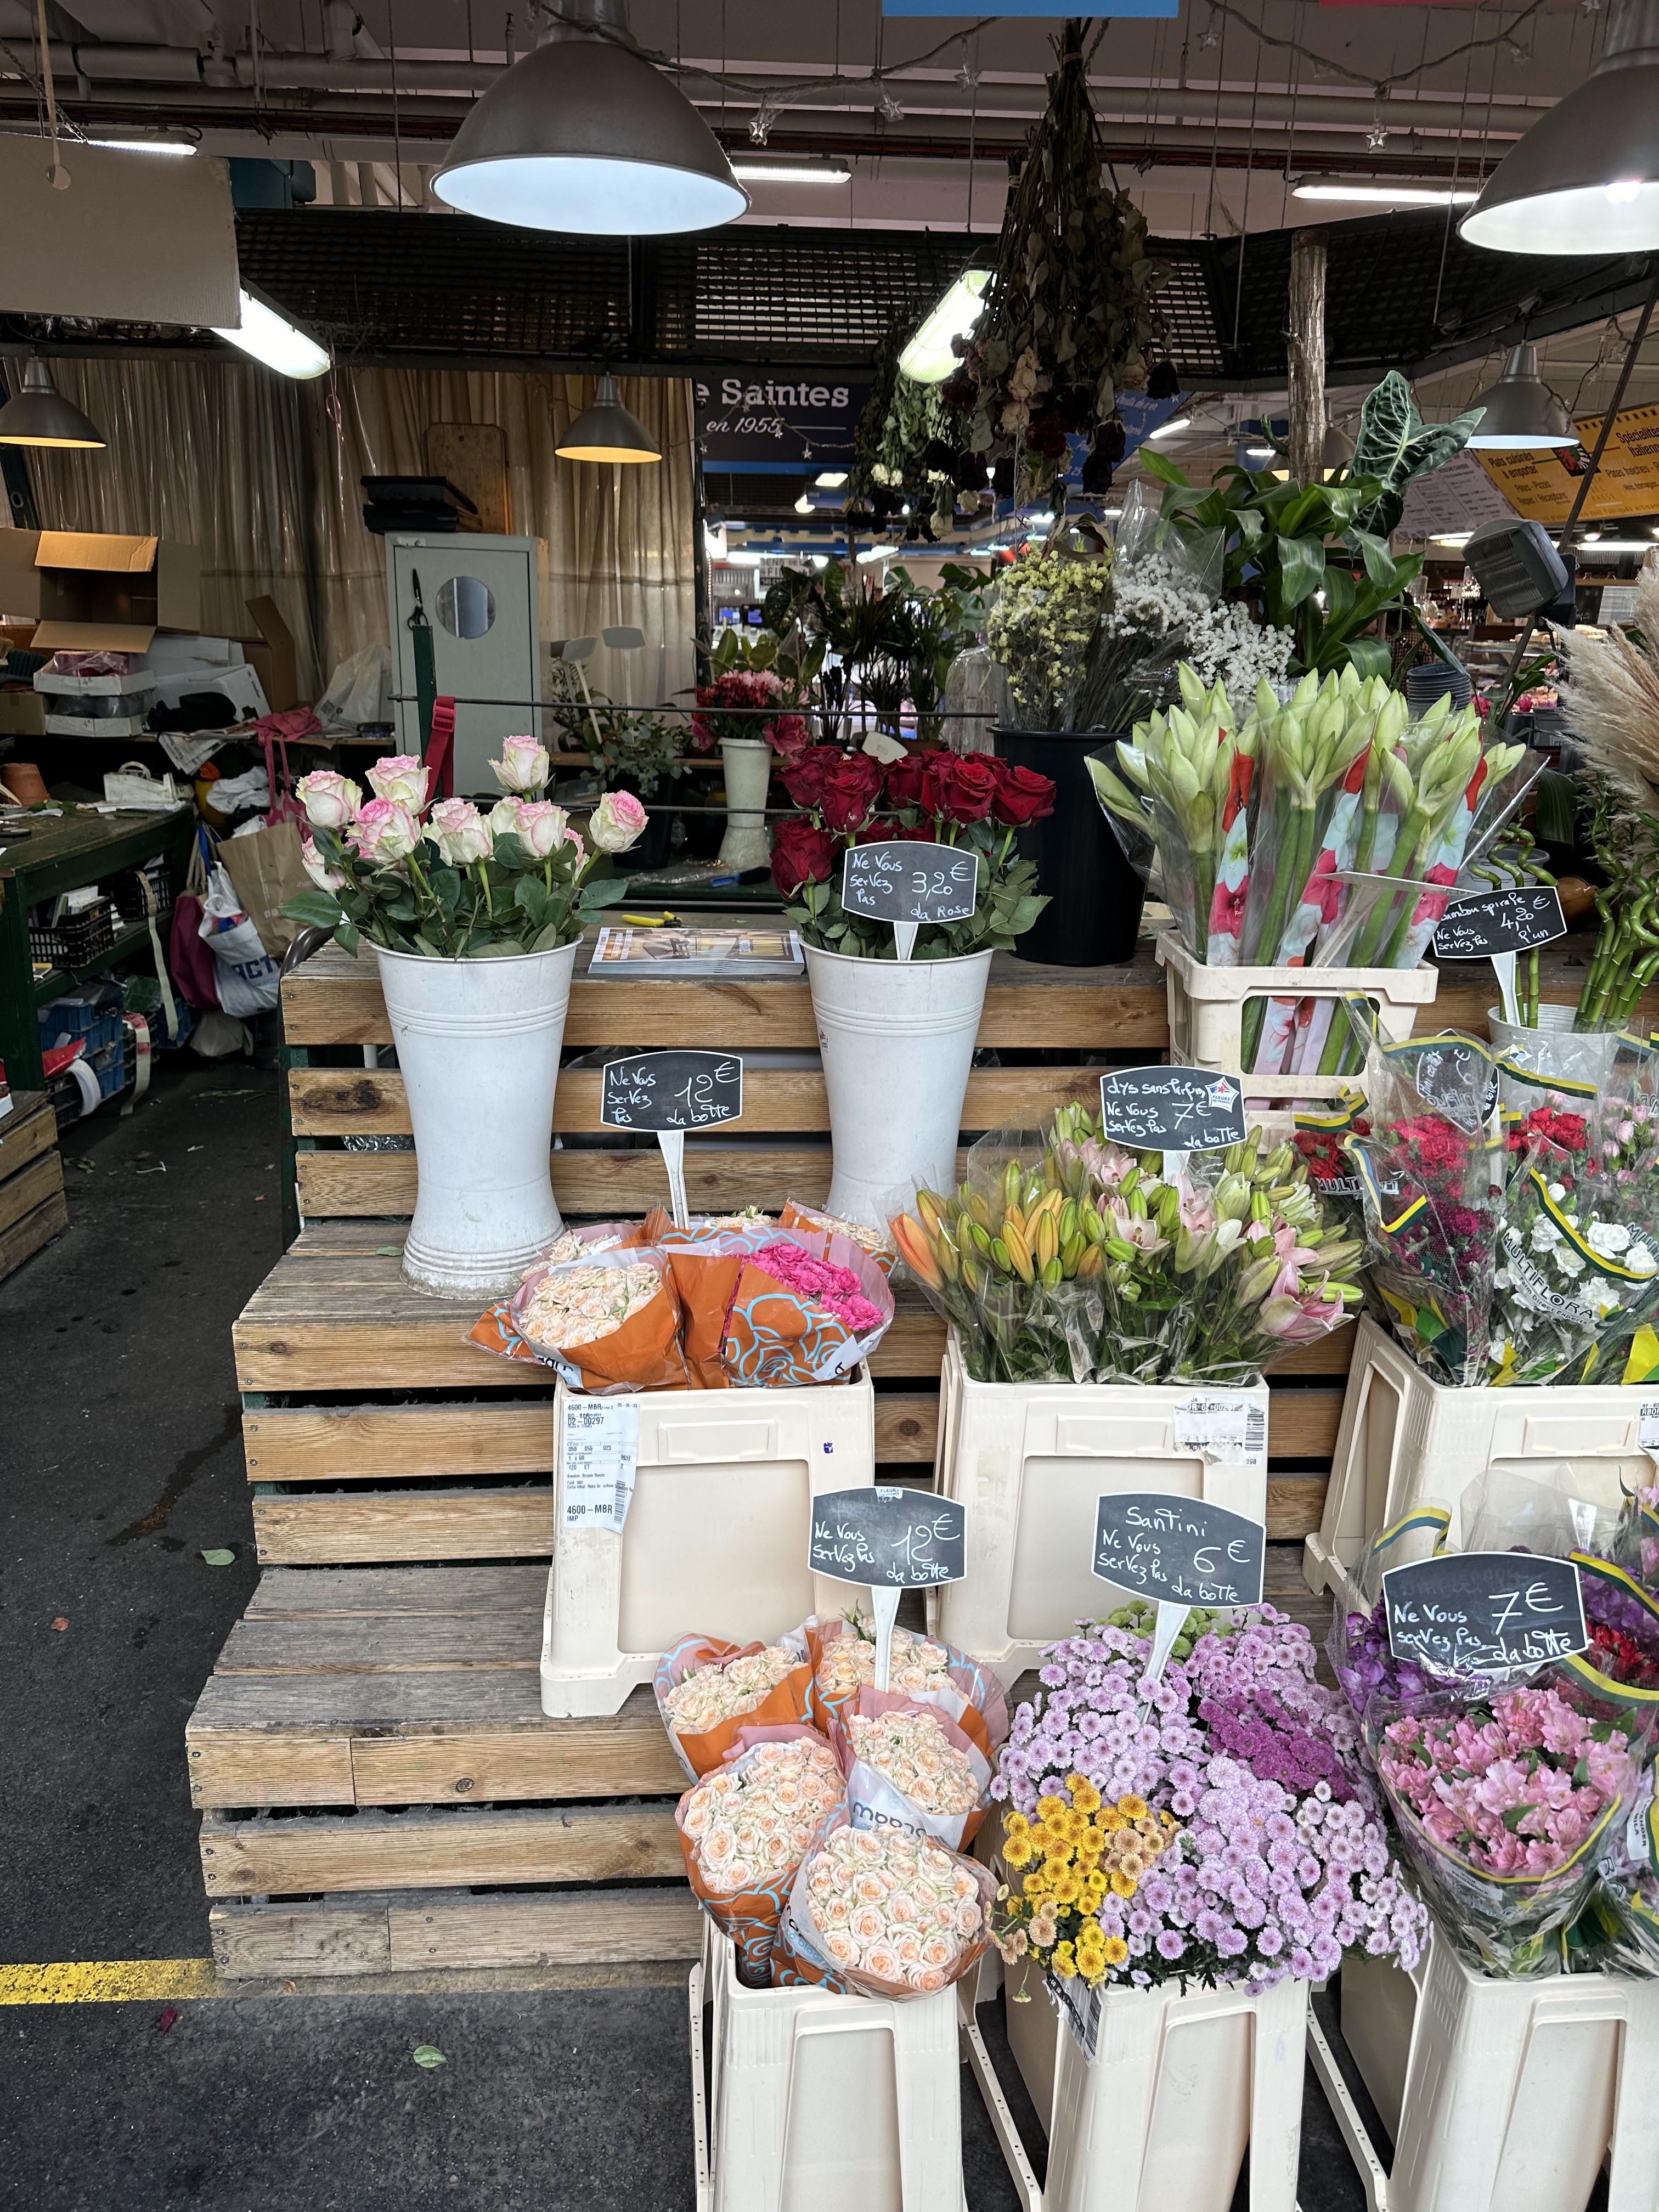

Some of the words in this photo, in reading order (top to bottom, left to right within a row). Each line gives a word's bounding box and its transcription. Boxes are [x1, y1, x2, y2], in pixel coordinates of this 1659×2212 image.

[722, 379, 849, 407] Saintes
[707, 420, 730, 432] en
[735, 417, 785, 433] 1955
[852, 853, 870, 868] Ne
[875, 851, 902, 871] Vous
[856, 888, 876, 905] Pas
[1441, 904, 1480, 921] ambou
[1437, 928, 1451, 940] Ne
[1453, 926, 1475, 936] Vous
[610, 1066, 630, 1086] Ne
[632, 1066, 656, 1087] Vous
[1142, 1083, 1168, 1094] sans
[1106, 1102, 1122, 1116] Ne
[1126, 1103, 1159, 1118] Vous
[1503, 1232, 1593, 1319] MULTIFLORA
[1532, 1295, 1555, 1312] Direct
[1556, 1311, 1588, 1325] Experts
[815, 1521, 833, 1539] Ne
[837, 1522, 866, 1542] Vous
[1125, 1506, 1207, 1537] Santini
[1103, 1529, 1121, 1548] Ne
[1128, 1532, 1161, 1555] Vous
[1395, 1601, 1420, 1624] Ne
[1423, 1604, 1467, 1623] Vous
